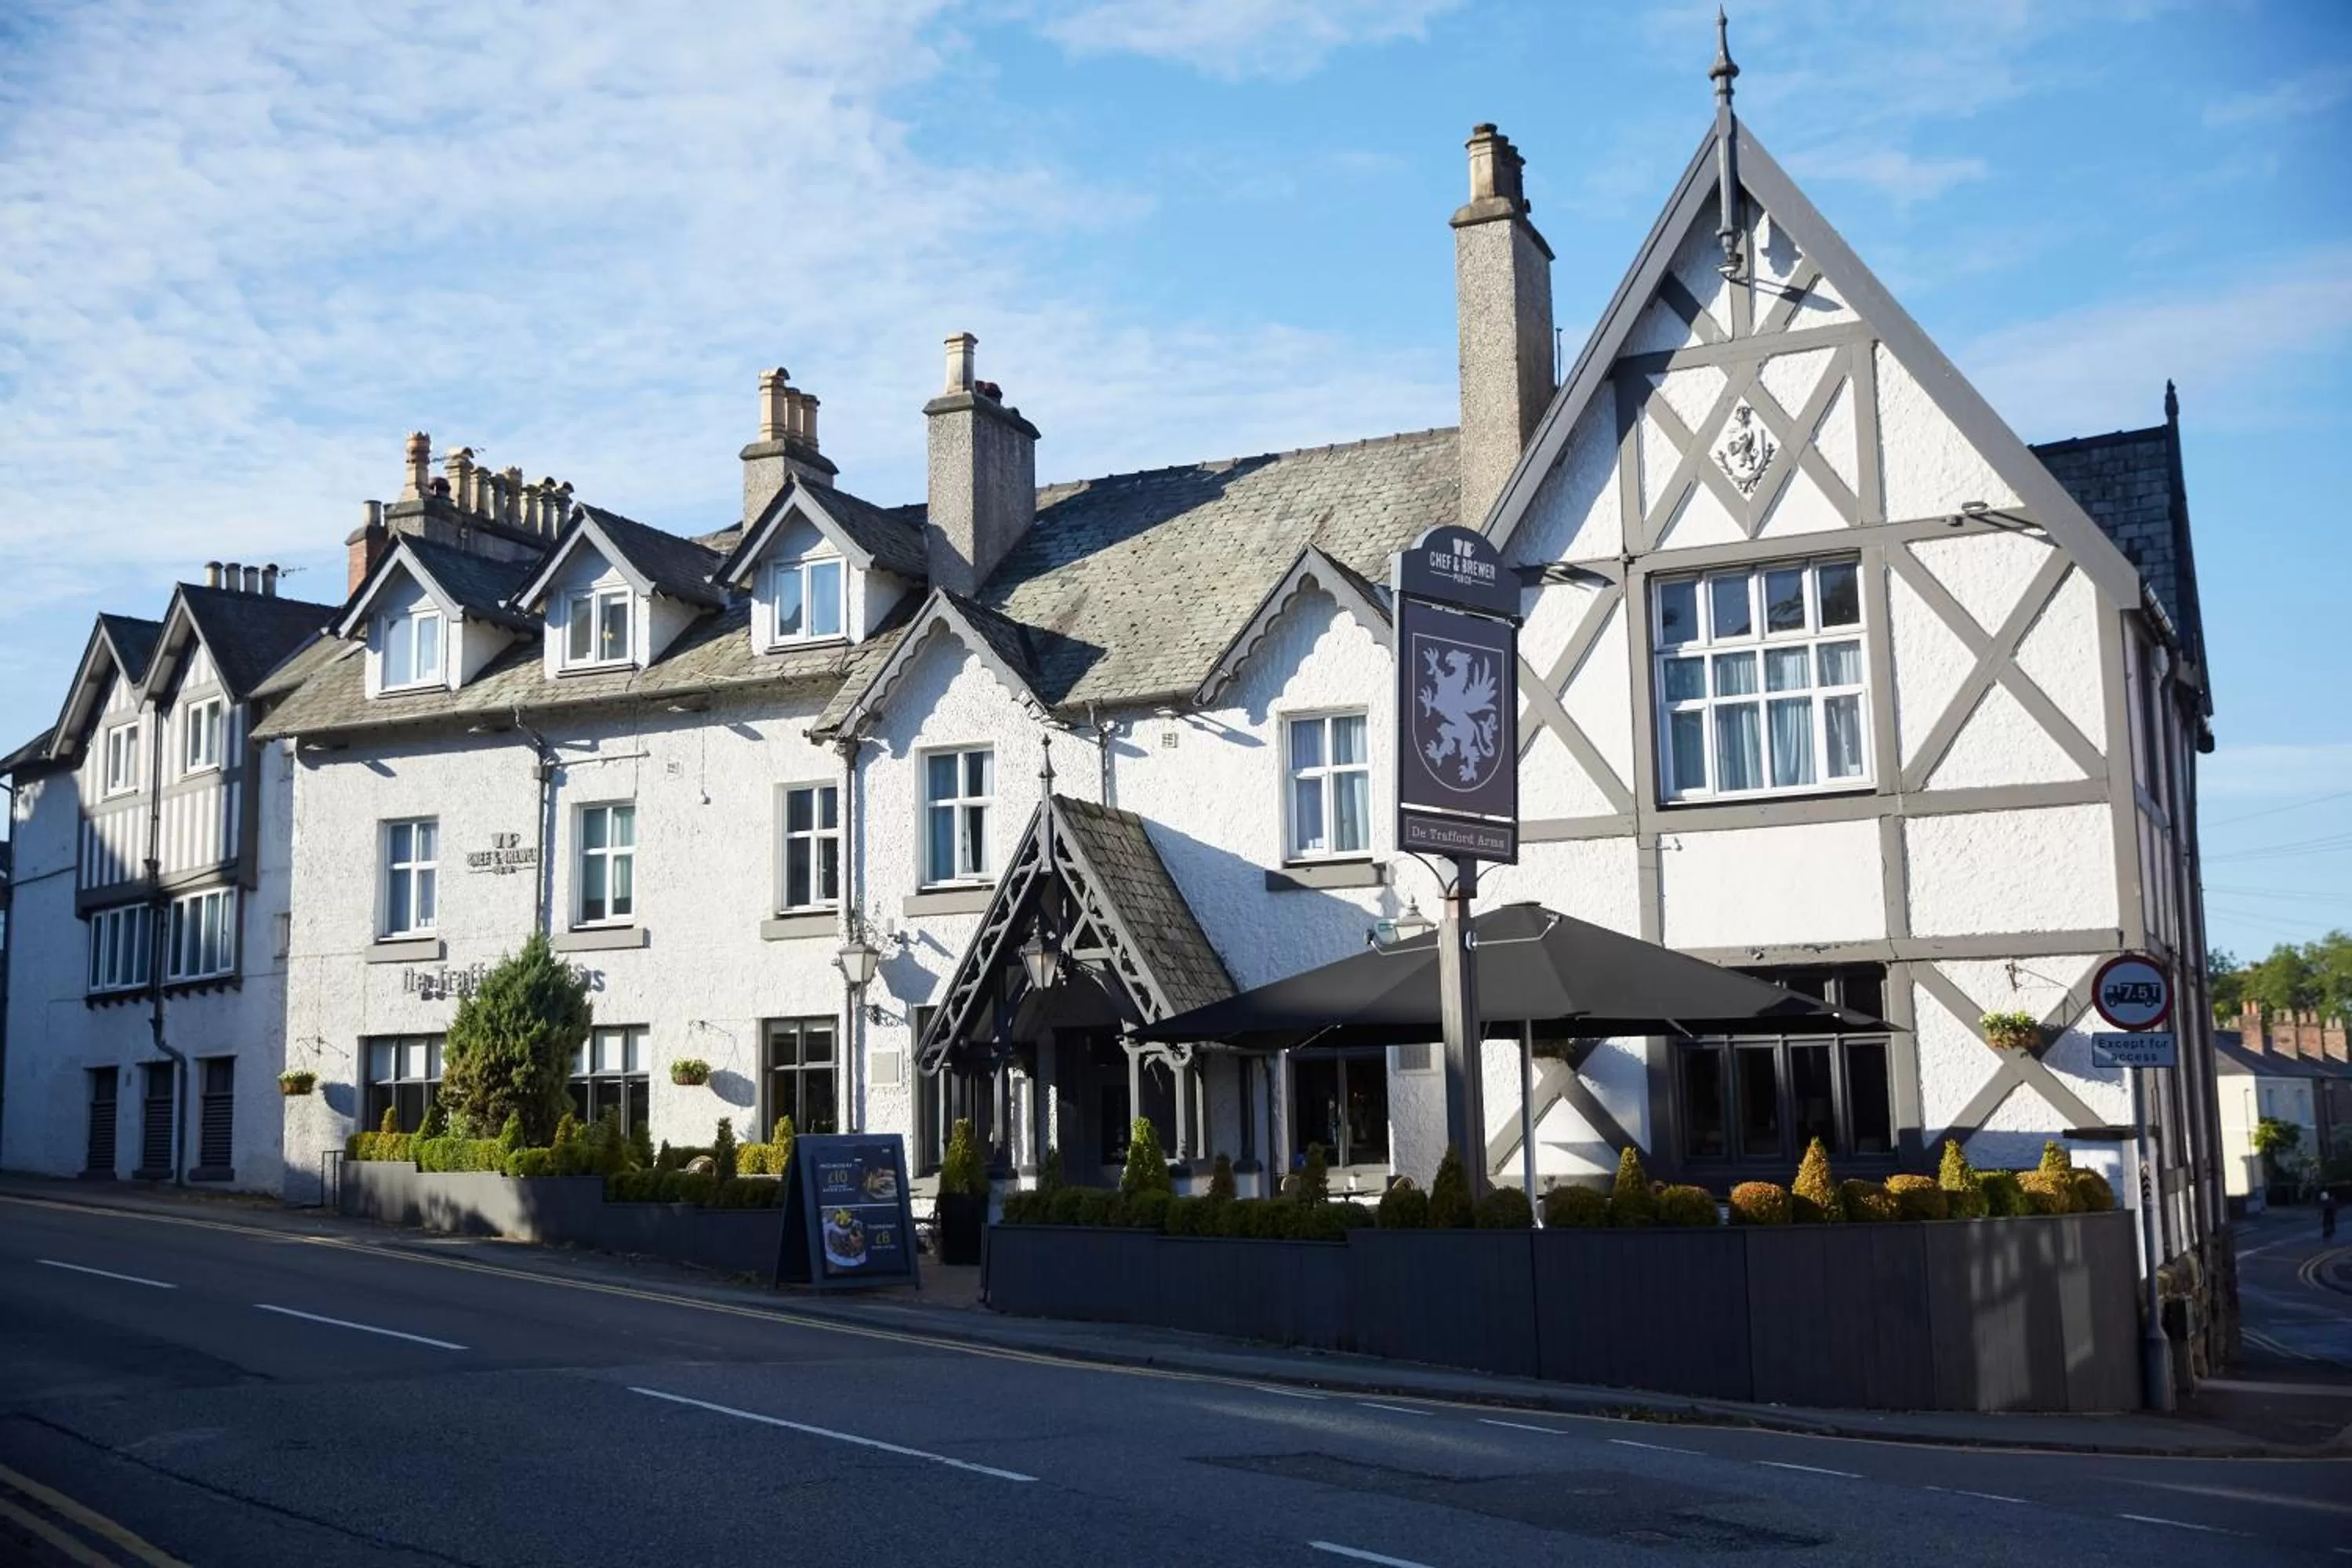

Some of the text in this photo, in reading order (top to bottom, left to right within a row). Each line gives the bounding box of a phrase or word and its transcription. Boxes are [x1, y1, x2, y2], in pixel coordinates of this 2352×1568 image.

[1430, 551, 1495, 579] CHEF & BREWER
[1412, 826, 1504, 848] De Trafford Arms
[2098, 1037, 2169, 1049] Except for
[2112, 1053, 2158, 1062] access
